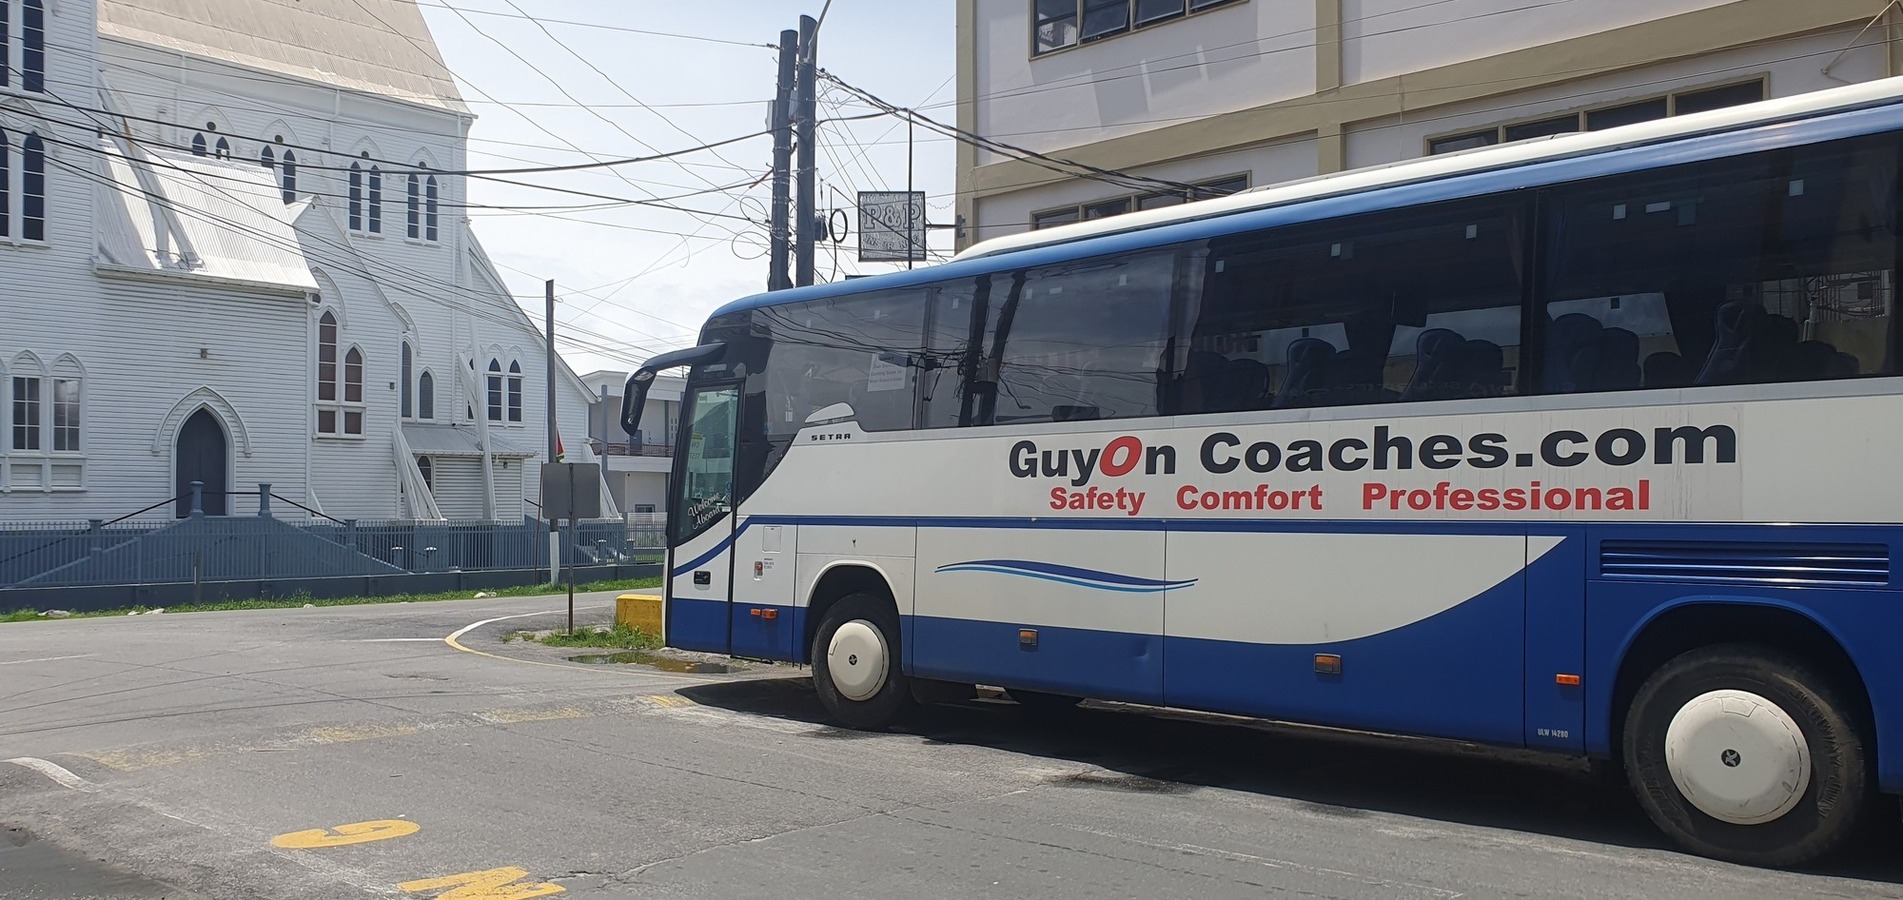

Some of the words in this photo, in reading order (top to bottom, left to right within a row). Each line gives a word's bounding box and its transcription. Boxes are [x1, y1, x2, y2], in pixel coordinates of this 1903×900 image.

[863, 203, 921, 230] P&P
[811, 433, 851, 441] SETRA
[1009, 435, 1176, 487] GuyOn
[1200, 424, 1736, 474] Coaches.com
[688, 492, 721, 517] Welcome
[1050, 486, 1146, 516] Safety
[1176, 484, 1323, 510] Comfort
[1362, 480, 1651, 511] Professional
[692, 504, 721, 529] Aboard
